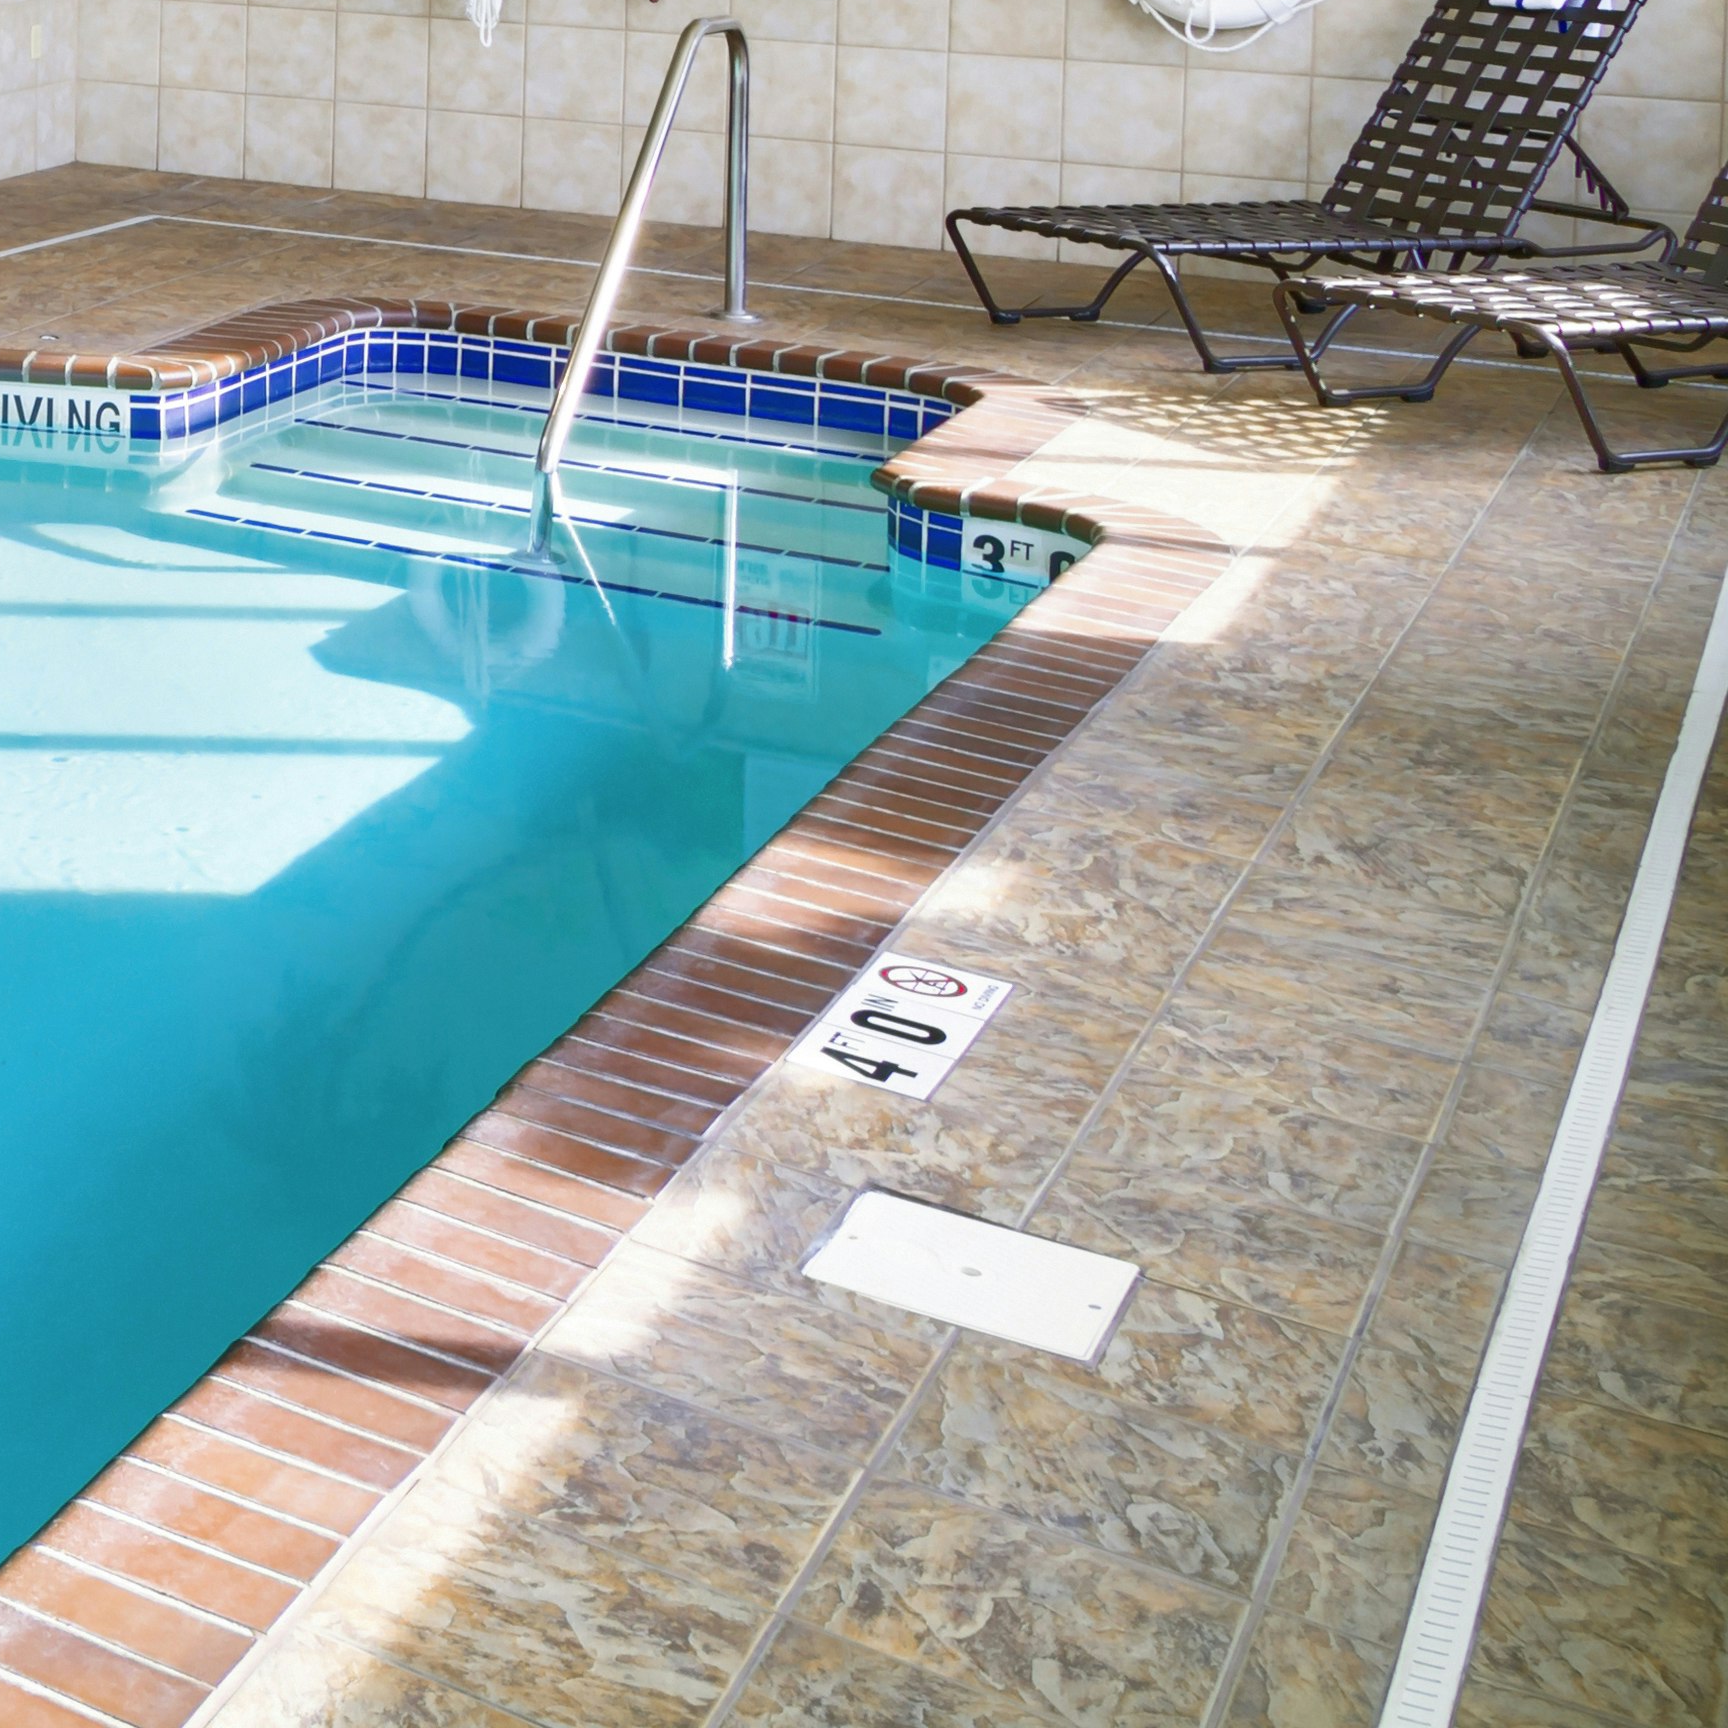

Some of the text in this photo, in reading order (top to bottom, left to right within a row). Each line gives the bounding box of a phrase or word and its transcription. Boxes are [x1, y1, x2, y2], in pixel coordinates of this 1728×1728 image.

[972, 534, 1006, 574] 3
[1010, 539, 1034, 561] FT
[819, 993, 947, 1083] 4 FT 0 IN
